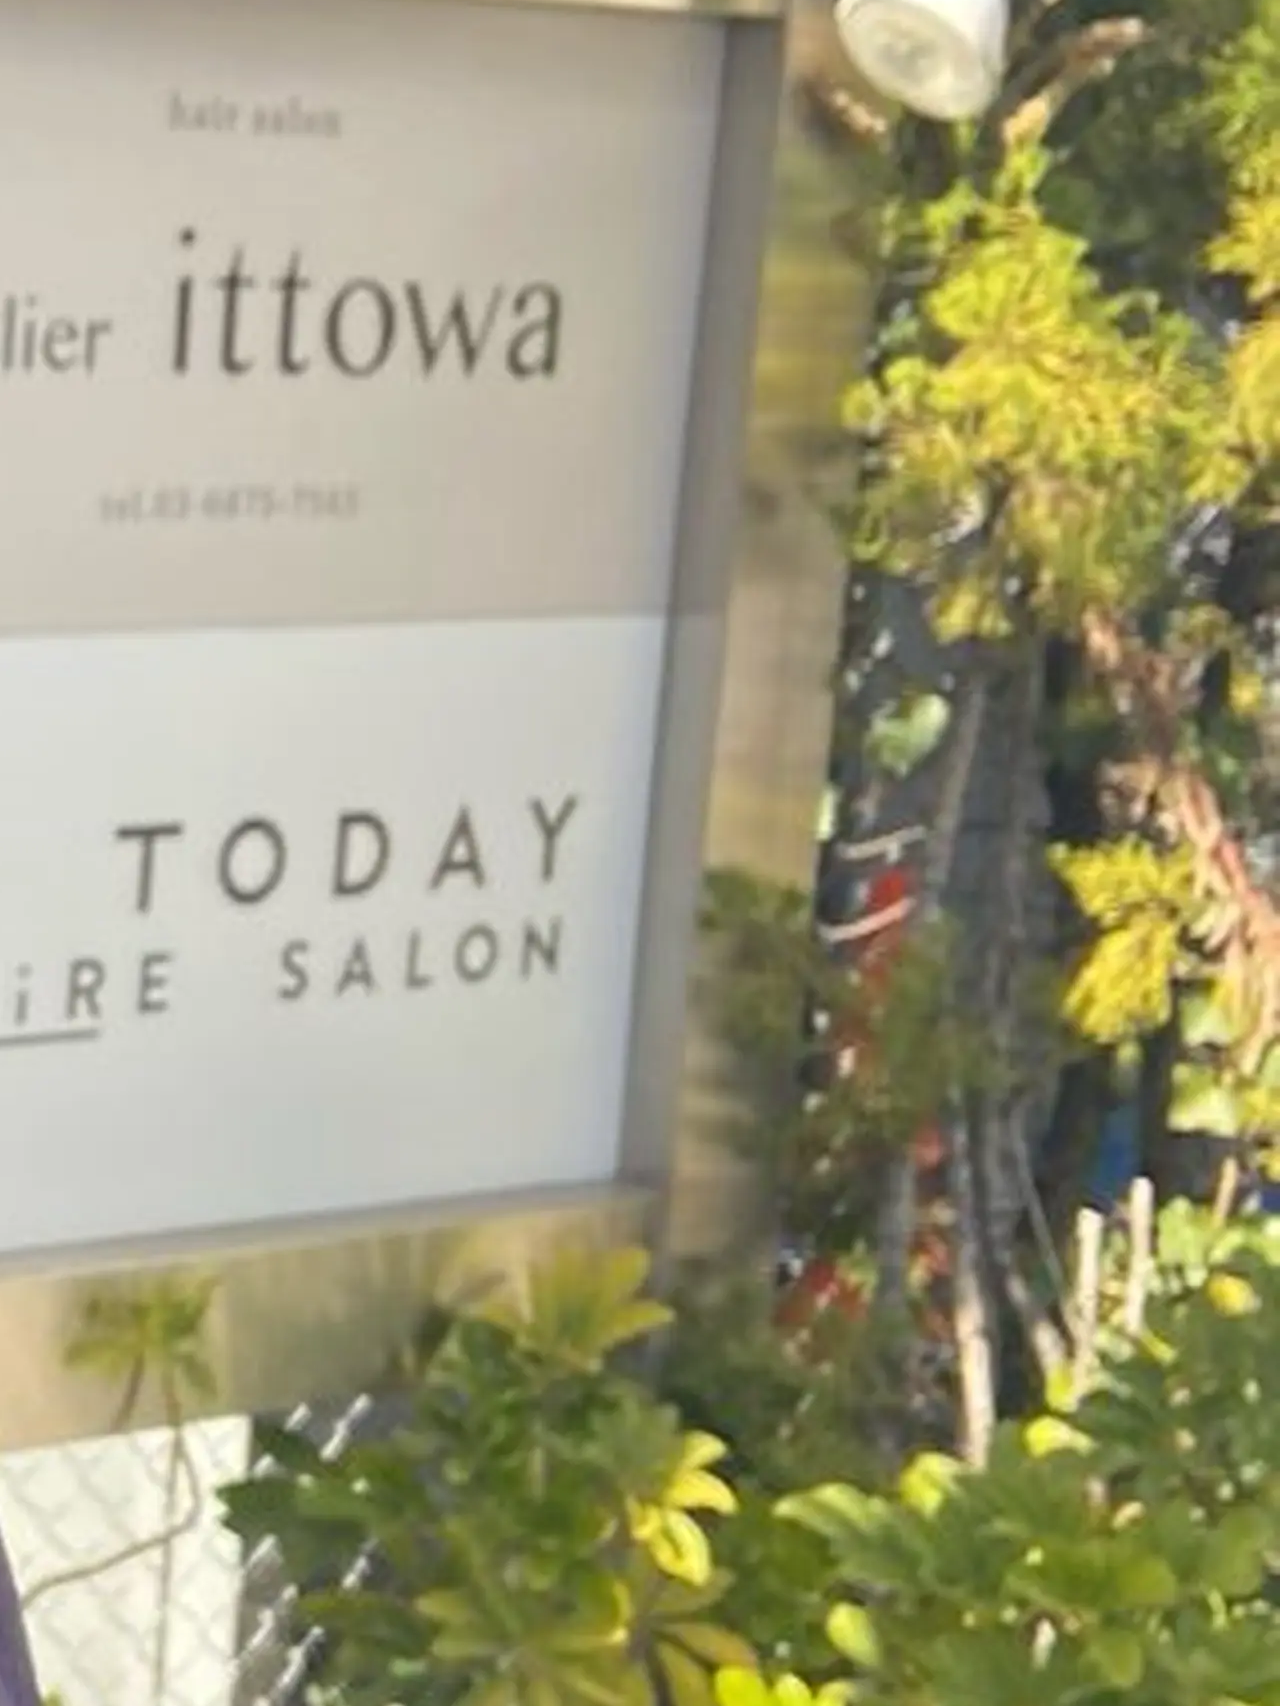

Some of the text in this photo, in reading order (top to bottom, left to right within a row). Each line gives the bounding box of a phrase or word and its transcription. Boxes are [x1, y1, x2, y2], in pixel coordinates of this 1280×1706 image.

[167, 90, 342, 140] hair salon
[172, 226, 564, 381] ittowa
[112, 794, 580, 914] TODAY
[276, 916, 564, 1002] SALON
